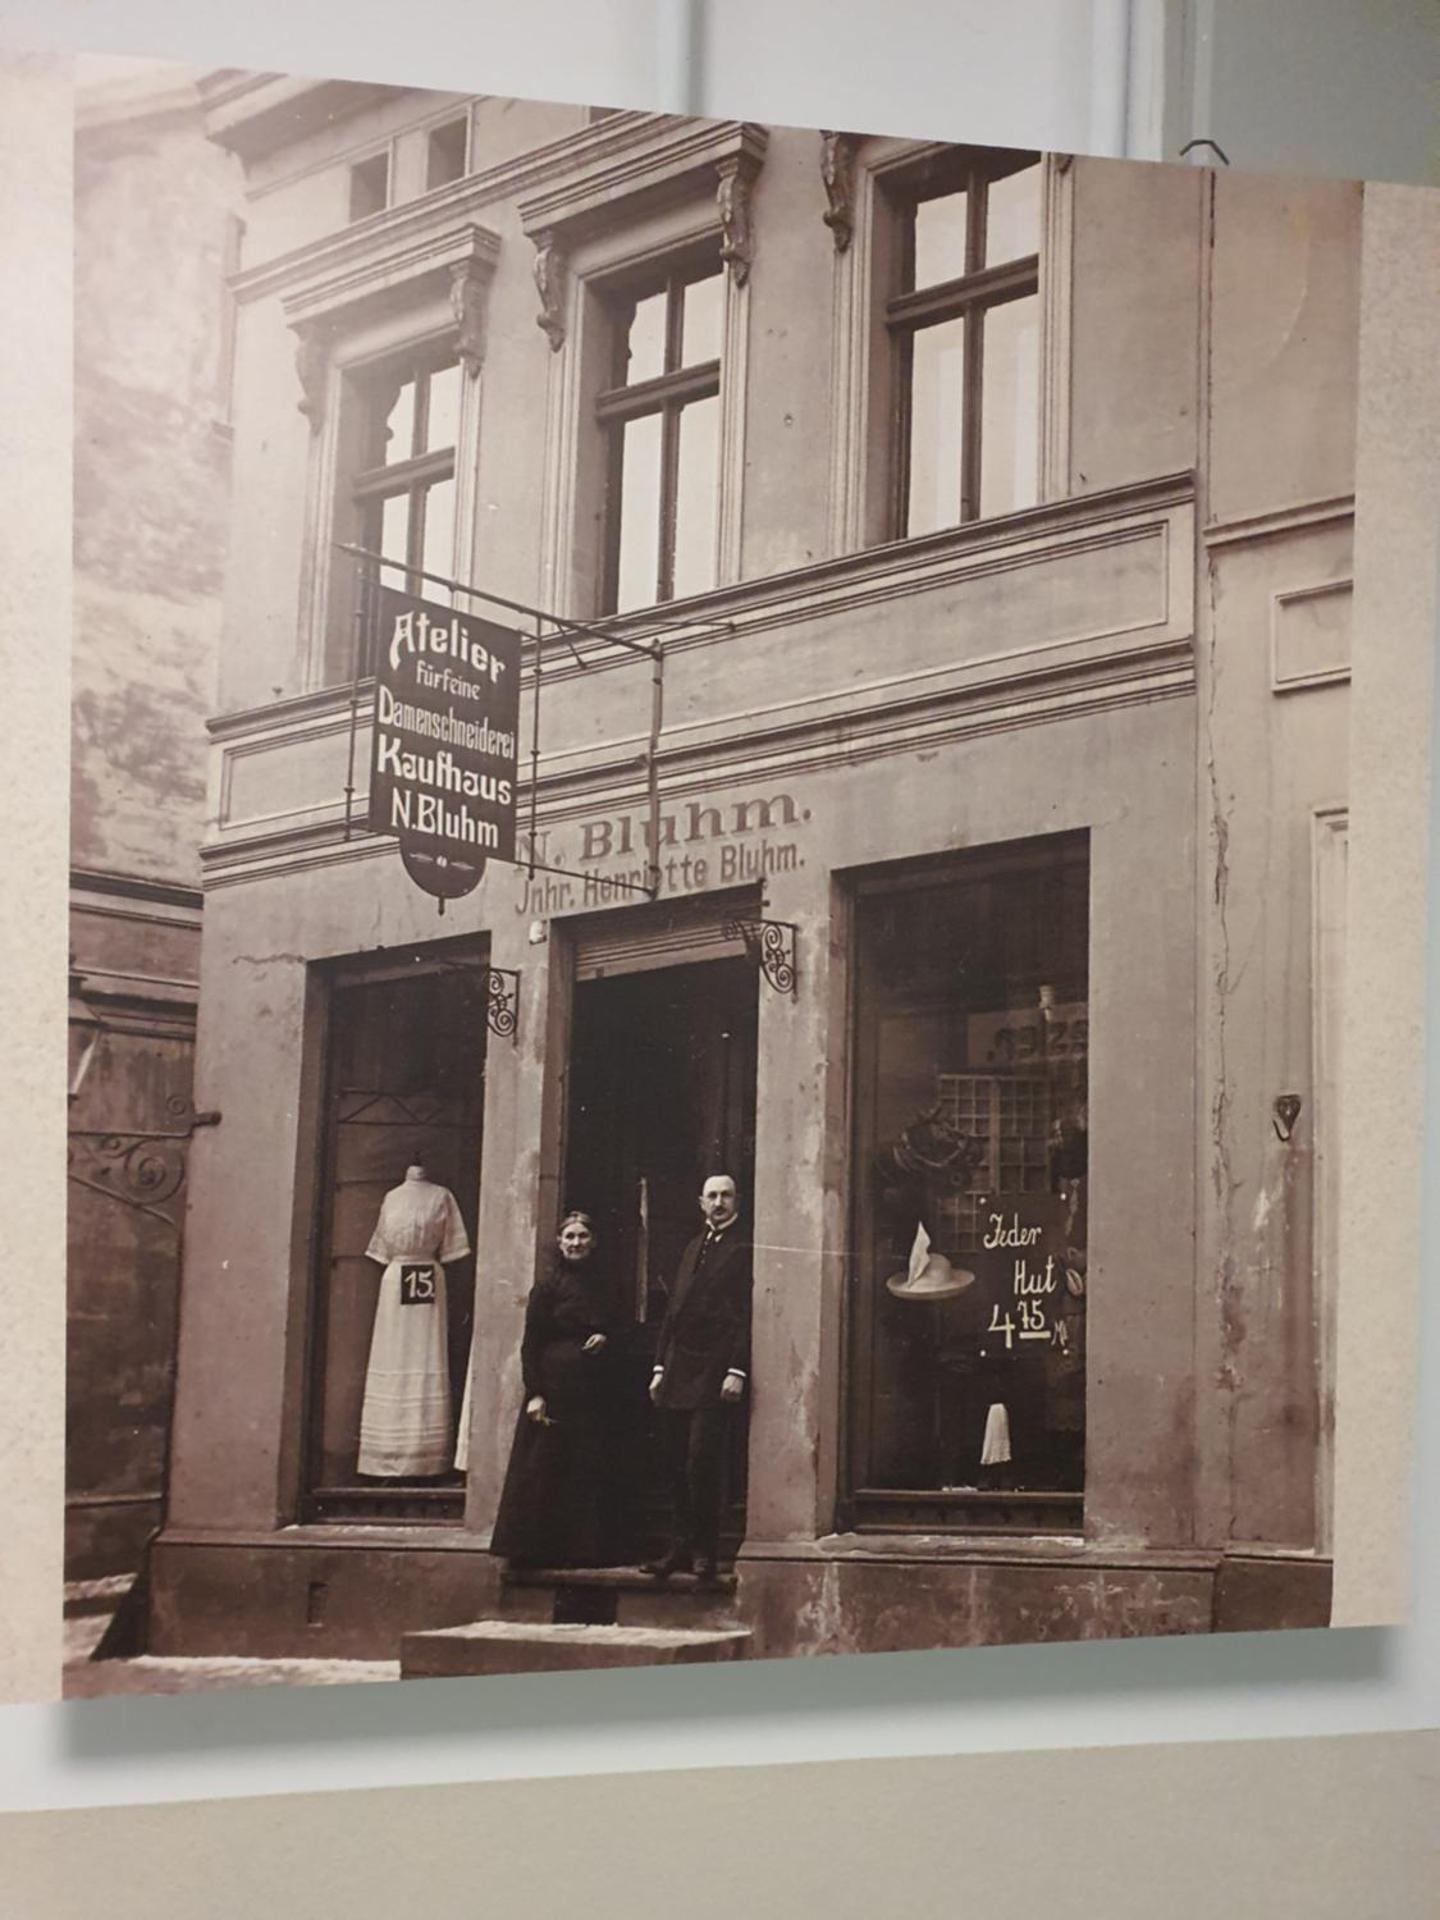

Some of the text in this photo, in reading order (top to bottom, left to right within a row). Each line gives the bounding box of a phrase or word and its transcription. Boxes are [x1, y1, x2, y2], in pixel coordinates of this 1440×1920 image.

[389, 611, 506, 684] Atelier
[416, 659, 481, 701] für feine
[378, 685, 515, 760] Damenschneiderei
[378, 733, 512, 805] Kaufhaus
[579, 794, 811, 861] Bluhm.
[721, 840, 805, 883] Bluhm.
[983, 1212, 1042, 1249] Jeder
[1014, 1255, 1057, 1295] Hut
